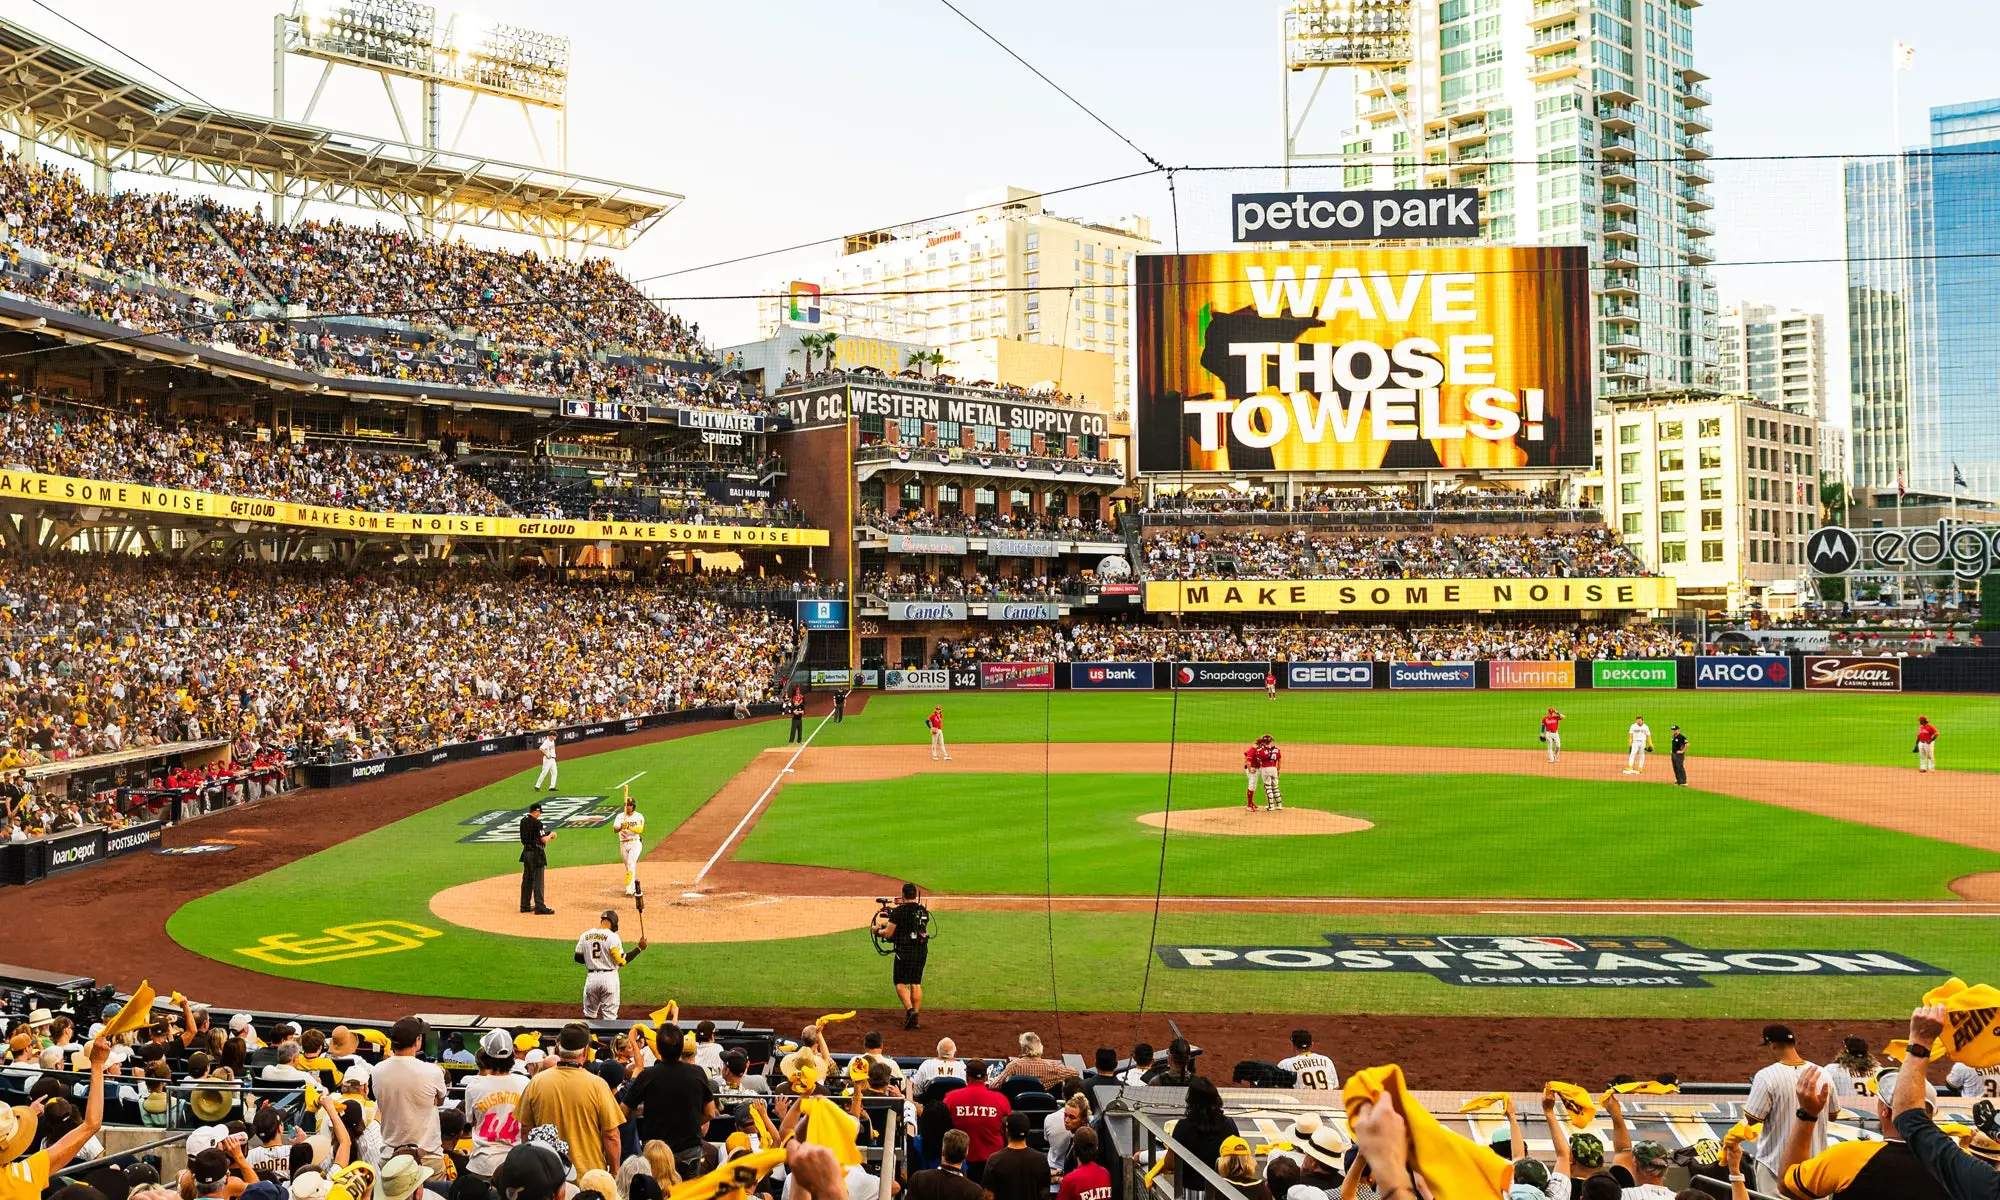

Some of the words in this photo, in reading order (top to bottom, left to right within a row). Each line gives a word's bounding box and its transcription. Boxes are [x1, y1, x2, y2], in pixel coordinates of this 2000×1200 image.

[1237, 197, 1364, 240] petco
[1373, 193, 1476, 236] park
[1245, 264, 1477, 324] WAVE
[834, 338, 899, 373] PADRES
[1228, 334, 1496, 394] THOSE
[817, 394, 847, 421] CO.
[850, 389, 939, 420] WESTERN
[948, 401, 1006, 427] METAL
[1010, 410, 1074, 433] SUPPLY
[1080, 415, 1107, 437] CO.
[689, 411, 756, 431] CUTWATER
[1184, 387, 1545, 451] TOWELS!
[701, 431, 743, 446] SPIRITS
[65, 483, 127, 502] SOME
[142, 491, 204, 511] NOISE
[729, 488, 744, 497] BALI
[745, 489, 755, 497] HAI
[756, 489, 770, 498] RUM
[231, 500, 250, 516] GET
[250, 501, 275, 517] LOUD
[298, 508, 340, 525] MAKE
[349, 514, 395, 529] SOME
[412, 518, 485, 532] NOISE
[518, 523, 541, 535] GET
[542, 523, 576, 535] LOUD
[602, 525, 656, 538] MAKE
[669, 528, 721, 540] SOME
[733, 530, 789, 542] NOISE
[1187, 585, 1306, 606] MAKE
[1339, 585, 1460, 604] SOME
[1493, 584, 1634, 603] NOISE
[905, 604, 954, 619] Canel's
[1003, 604, 1047, 619] Canel's
[861, 621, 879, 635] 336
[908, 672, 946, 684] ORIS
[955, 673, 976, 686] 342
[1089, 671, 1104, 680] us
[1106, 668, 1136, 680] bank
[1200, 670, 1265, 683] Snapdragon
[1291, 667, 1370, 682] GEICO
[1395, 670, 1460, 681] Southwest
[1495, 667, 1569, 684] illumina
[1699, 664, 1764, 681] ARCO
[1811, 659, 1891, 687] Sycuan
[352, 761, 385, 778] loanDepot
[111, 831, 150, 851] POSTSEASON
[52, 840, 96, 866] loanDepot
[592, 941, 601, 959] 2
[1352, 938, 1437, 947] 20
[1177, 948, 1921, 973] POSTSEASON
[1460, 974, 1685, 985] loanDepot
[1292, 1058, 1327, 1071] CERVELLI
[1302, 1070, 1328, 1090] 99
[956, 1105, 998, 1118] ELITE
[479, 1112, 520, 1144] 44
[253, 1158, 291, 1172] PROFA
